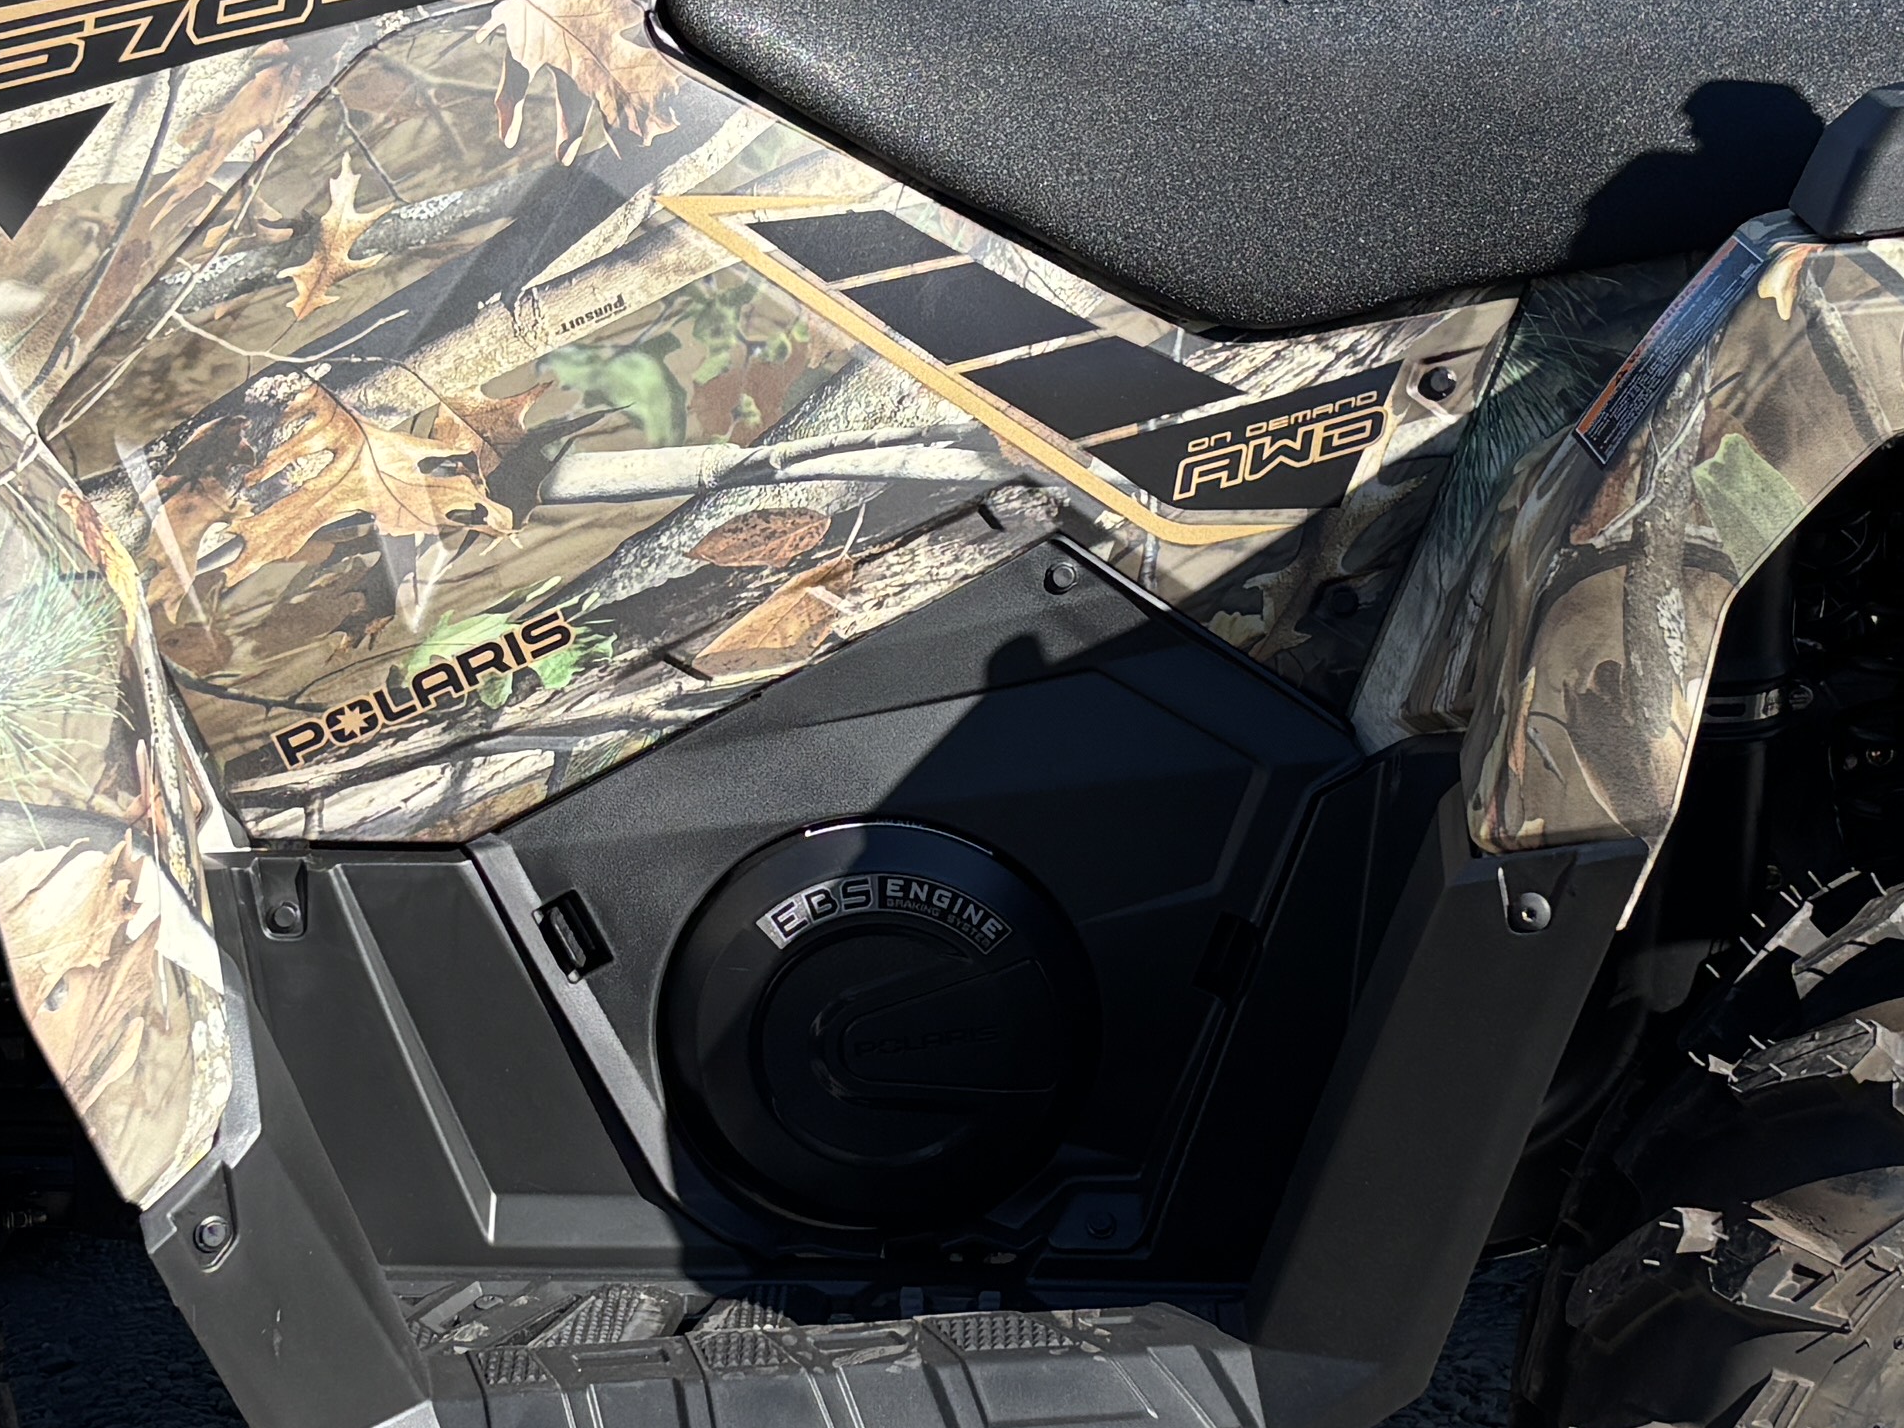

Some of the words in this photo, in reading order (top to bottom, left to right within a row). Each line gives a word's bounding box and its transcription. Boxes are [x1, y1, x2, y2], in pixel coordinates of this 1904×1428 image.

[559, 293, 625, 334] PURSUIT
[1172, 406, 1388, 501] AWD
[1188, 431, 1232, 453] ON
[1246, 390, 1378, 438] DEMAND
[272, 609, 574, 769] POLARIS
[768, 877, 874, 942] EBS
[885, 877, 1004, 942] ENGINE
[852, 1024, 1000, 1058] POLARIS
